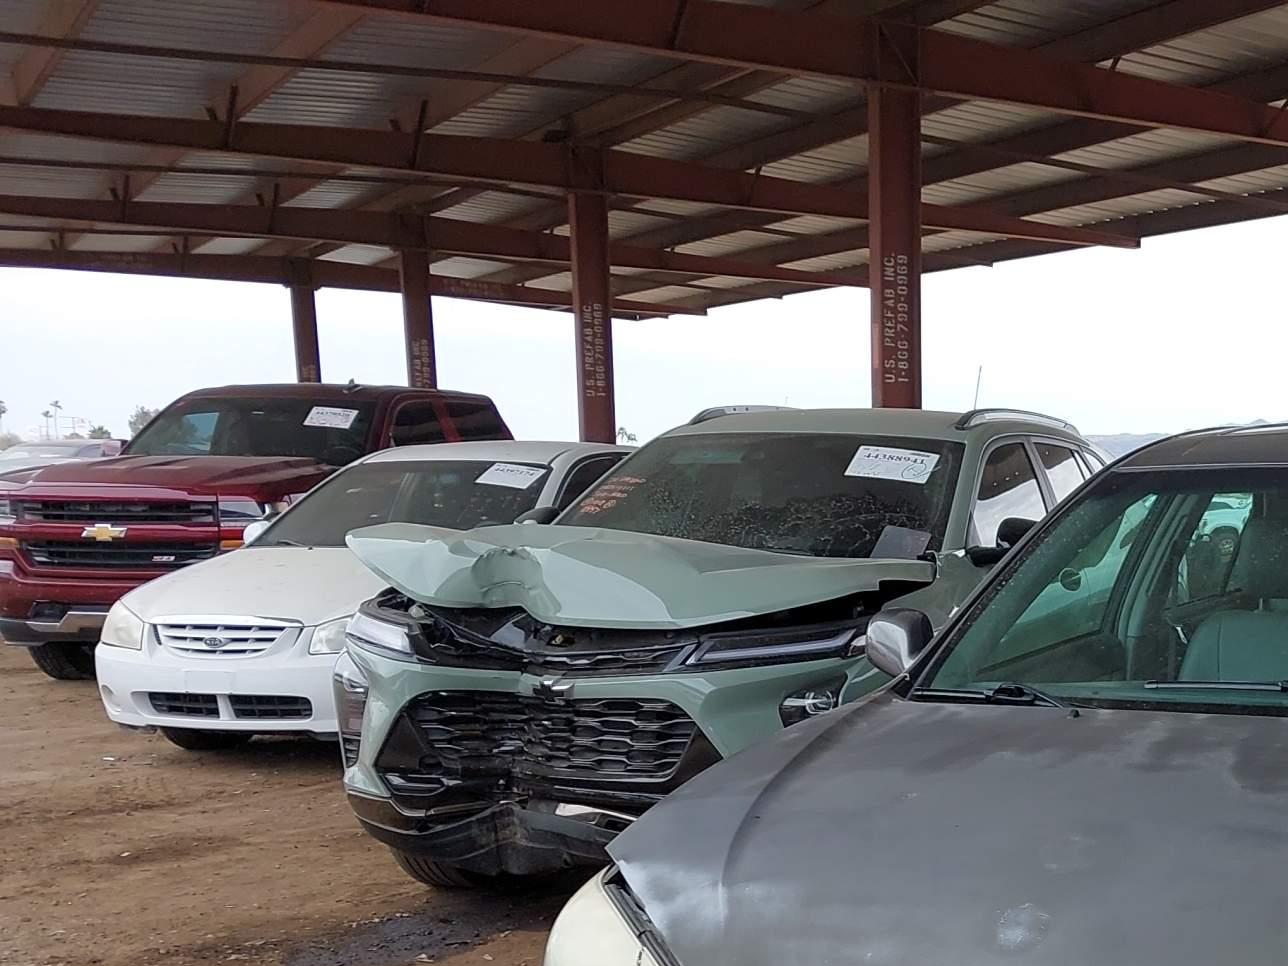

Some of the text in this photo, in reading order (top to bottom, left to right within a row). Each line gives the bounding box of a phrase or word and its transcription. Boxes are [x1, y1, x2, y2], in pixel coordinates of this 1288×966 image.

[883, 252, 896, 383] U.S. PREFAB INC.
